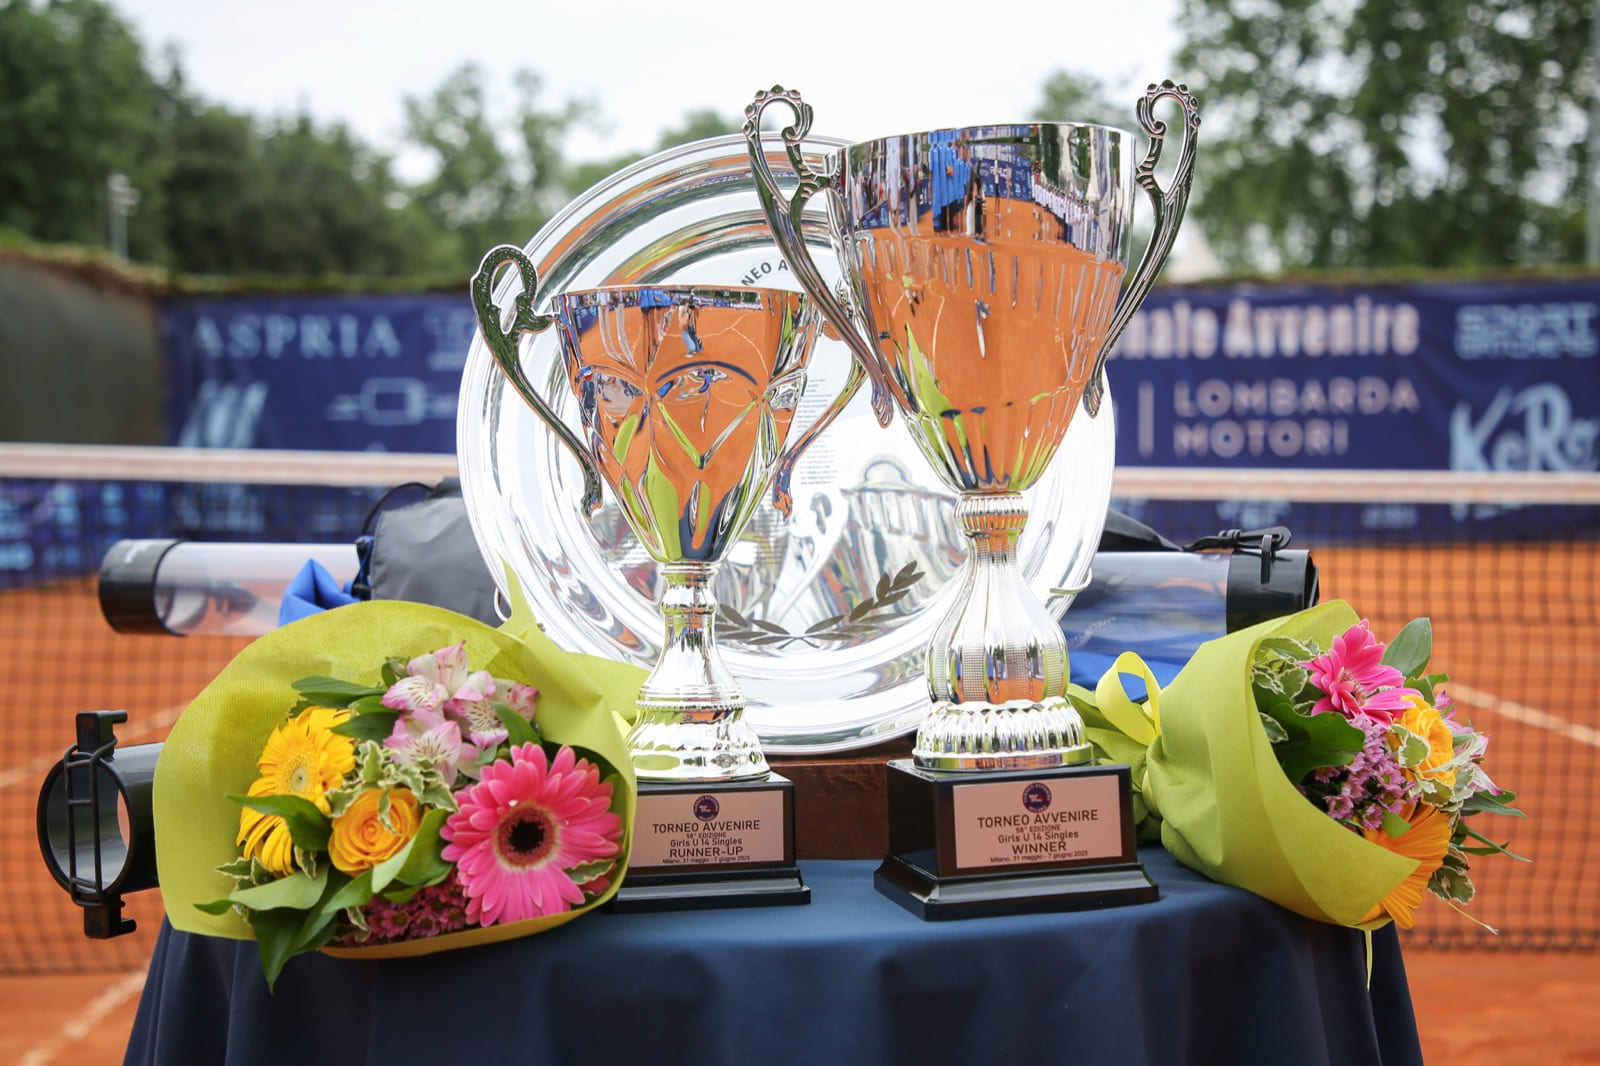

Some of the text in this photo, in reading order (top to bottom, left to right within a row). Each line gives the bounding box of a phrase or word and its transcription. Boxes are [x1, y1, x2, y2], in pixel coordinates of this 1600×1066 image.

[1108, 297, 1218, 360] nale
[1222, 296, 1419, 358] Avvenire
[193, 312, 402, 360] ASPRIA
[1173, 376, 1420, 417] LOMBARDA
[1173, 418, 1349, 458] MOTORI
[977, 809, 1099, 829] TORNEO AVVENIRE
[652, 820, 760, 834] TORNEO AVVENIRE
[1029, 824, 1061, 833] EDIZIONE
[698, 831, 727, 839] EDIZIONE
[998, 831, 1079, 843] Girls U 14 Singles
[670, 839, 690, 848] Girls
[701, 838, 710, 846] 14
[712, 837, 743, 847] Singles
[1012, 841, 1067, 855] WINNER
[669, 846, 743, 858] RUNNER-UP
[1021, 854, 1043, 862] maggio
[1053, 852, 1073, 860] giugno
